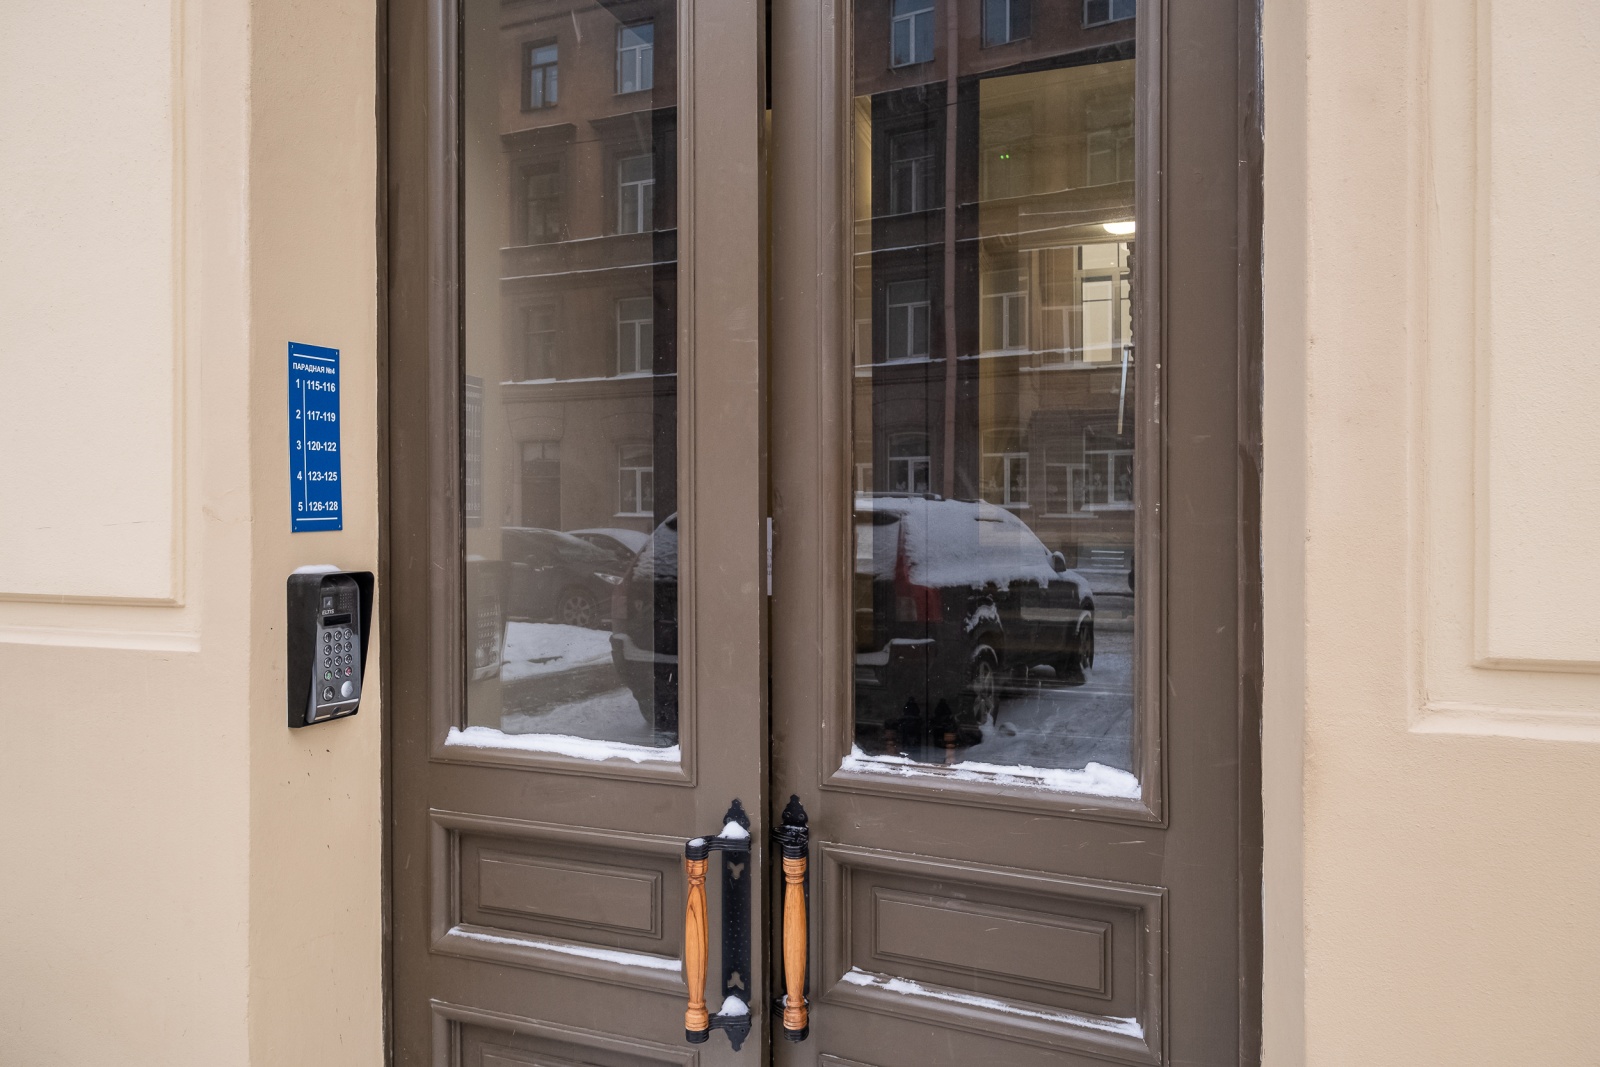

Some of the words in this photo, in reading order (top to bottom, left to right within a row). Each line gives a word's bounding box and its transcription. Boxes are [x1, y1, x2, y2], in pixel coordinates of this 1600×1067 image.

[293, 362, 325, 374] ПАРАДНАЯ
[326, 367, 336, 375] №4
[295, 378, 300, 389] 1
[307, 380, 336, 392] 115-116
[295, 408, 302, 420] 2
[307, 410, 336, 422] 117-119
[296, 439, 302, 451] 3
[307, 440, 337, 452] 120-122
[296, 470, 303, 481] 4
[307, 470, 338, 482] 123-125
[297, 501, 304, 512] 5
[308, 501, 339, 512] 126-128
